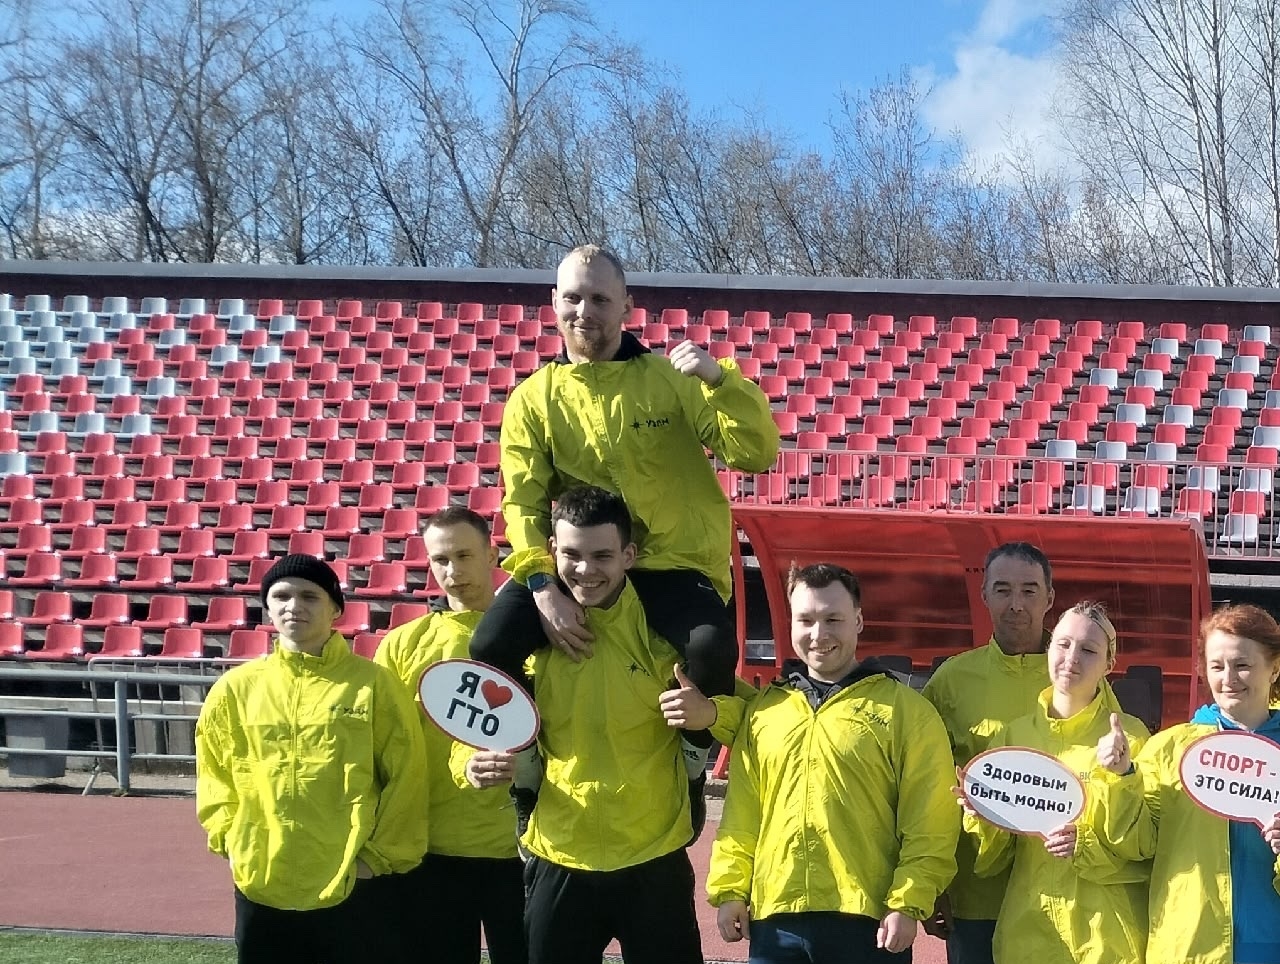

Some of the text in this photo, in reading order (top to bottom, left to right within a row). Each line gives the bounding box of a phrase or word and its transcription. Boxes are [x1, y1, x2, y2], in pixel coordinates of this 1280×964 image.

[455, 670, 482, 699] Я
[446, 697, 500, 737] ГТО
[982, 762, 1068, 792] Здоровым
[1199, 748, 1267, 778] СПОРТ
[970, 782, 1073, 815] быть модно!
[1194, 774, 1280, 804] ЭТО СИЛА!
